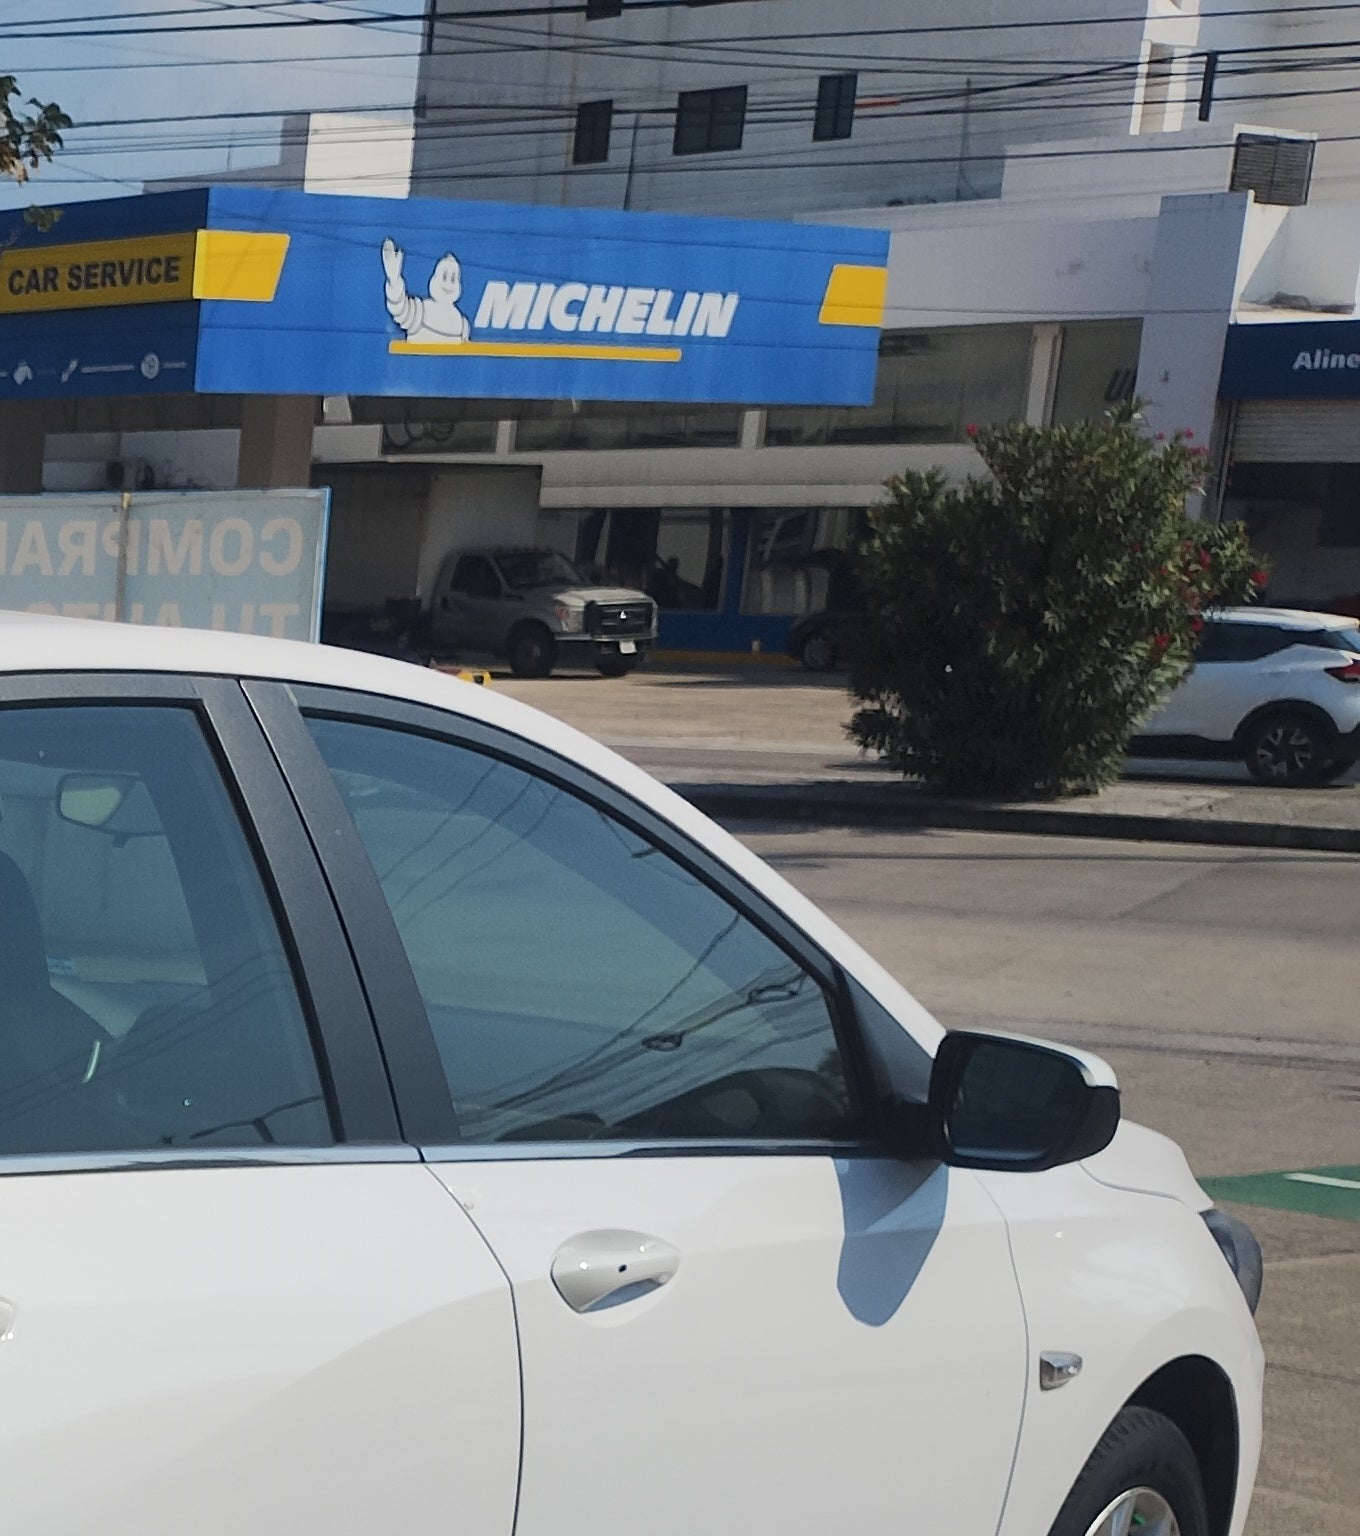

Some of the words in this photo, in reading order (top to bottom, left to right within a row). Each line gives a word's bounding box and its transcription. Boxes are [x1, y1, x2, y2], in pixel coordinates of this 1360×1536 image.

[7, 265, 60, 297] CAR
[66, 254, 182, 293] SERVICE
[473, 280, 740, 338] MICHELIN
[1292, 348, 1360, 371] Aline
